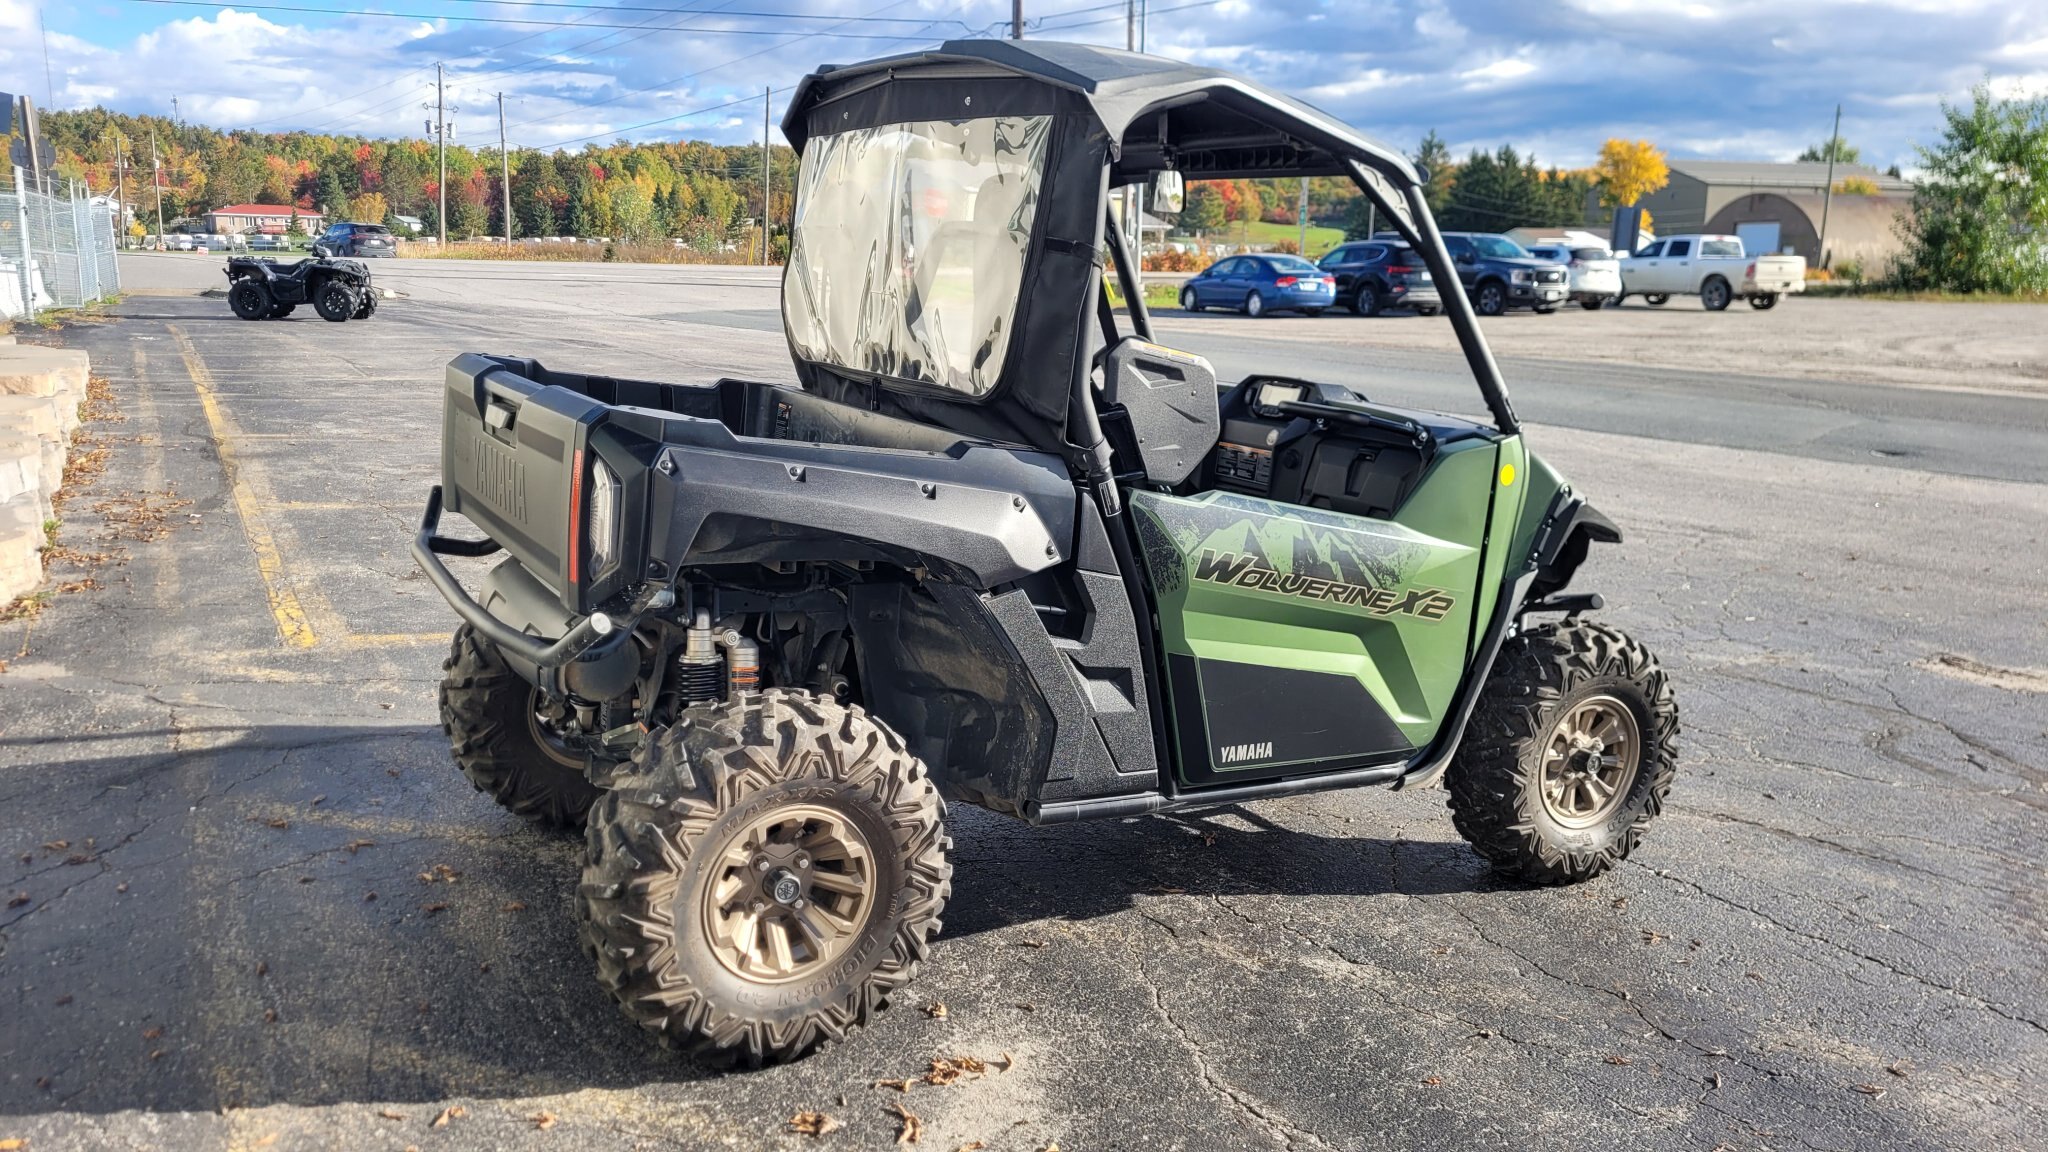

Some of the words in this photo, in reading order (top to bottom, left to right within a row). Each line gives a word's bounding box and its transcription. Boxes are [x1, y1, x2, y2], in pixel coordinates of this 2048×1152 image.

[473, 435, 528, 524] YAMAHA
[1220, 741, 1273, 763] YAMAHA
[777, 932, 879, 1008] BIGHORN
